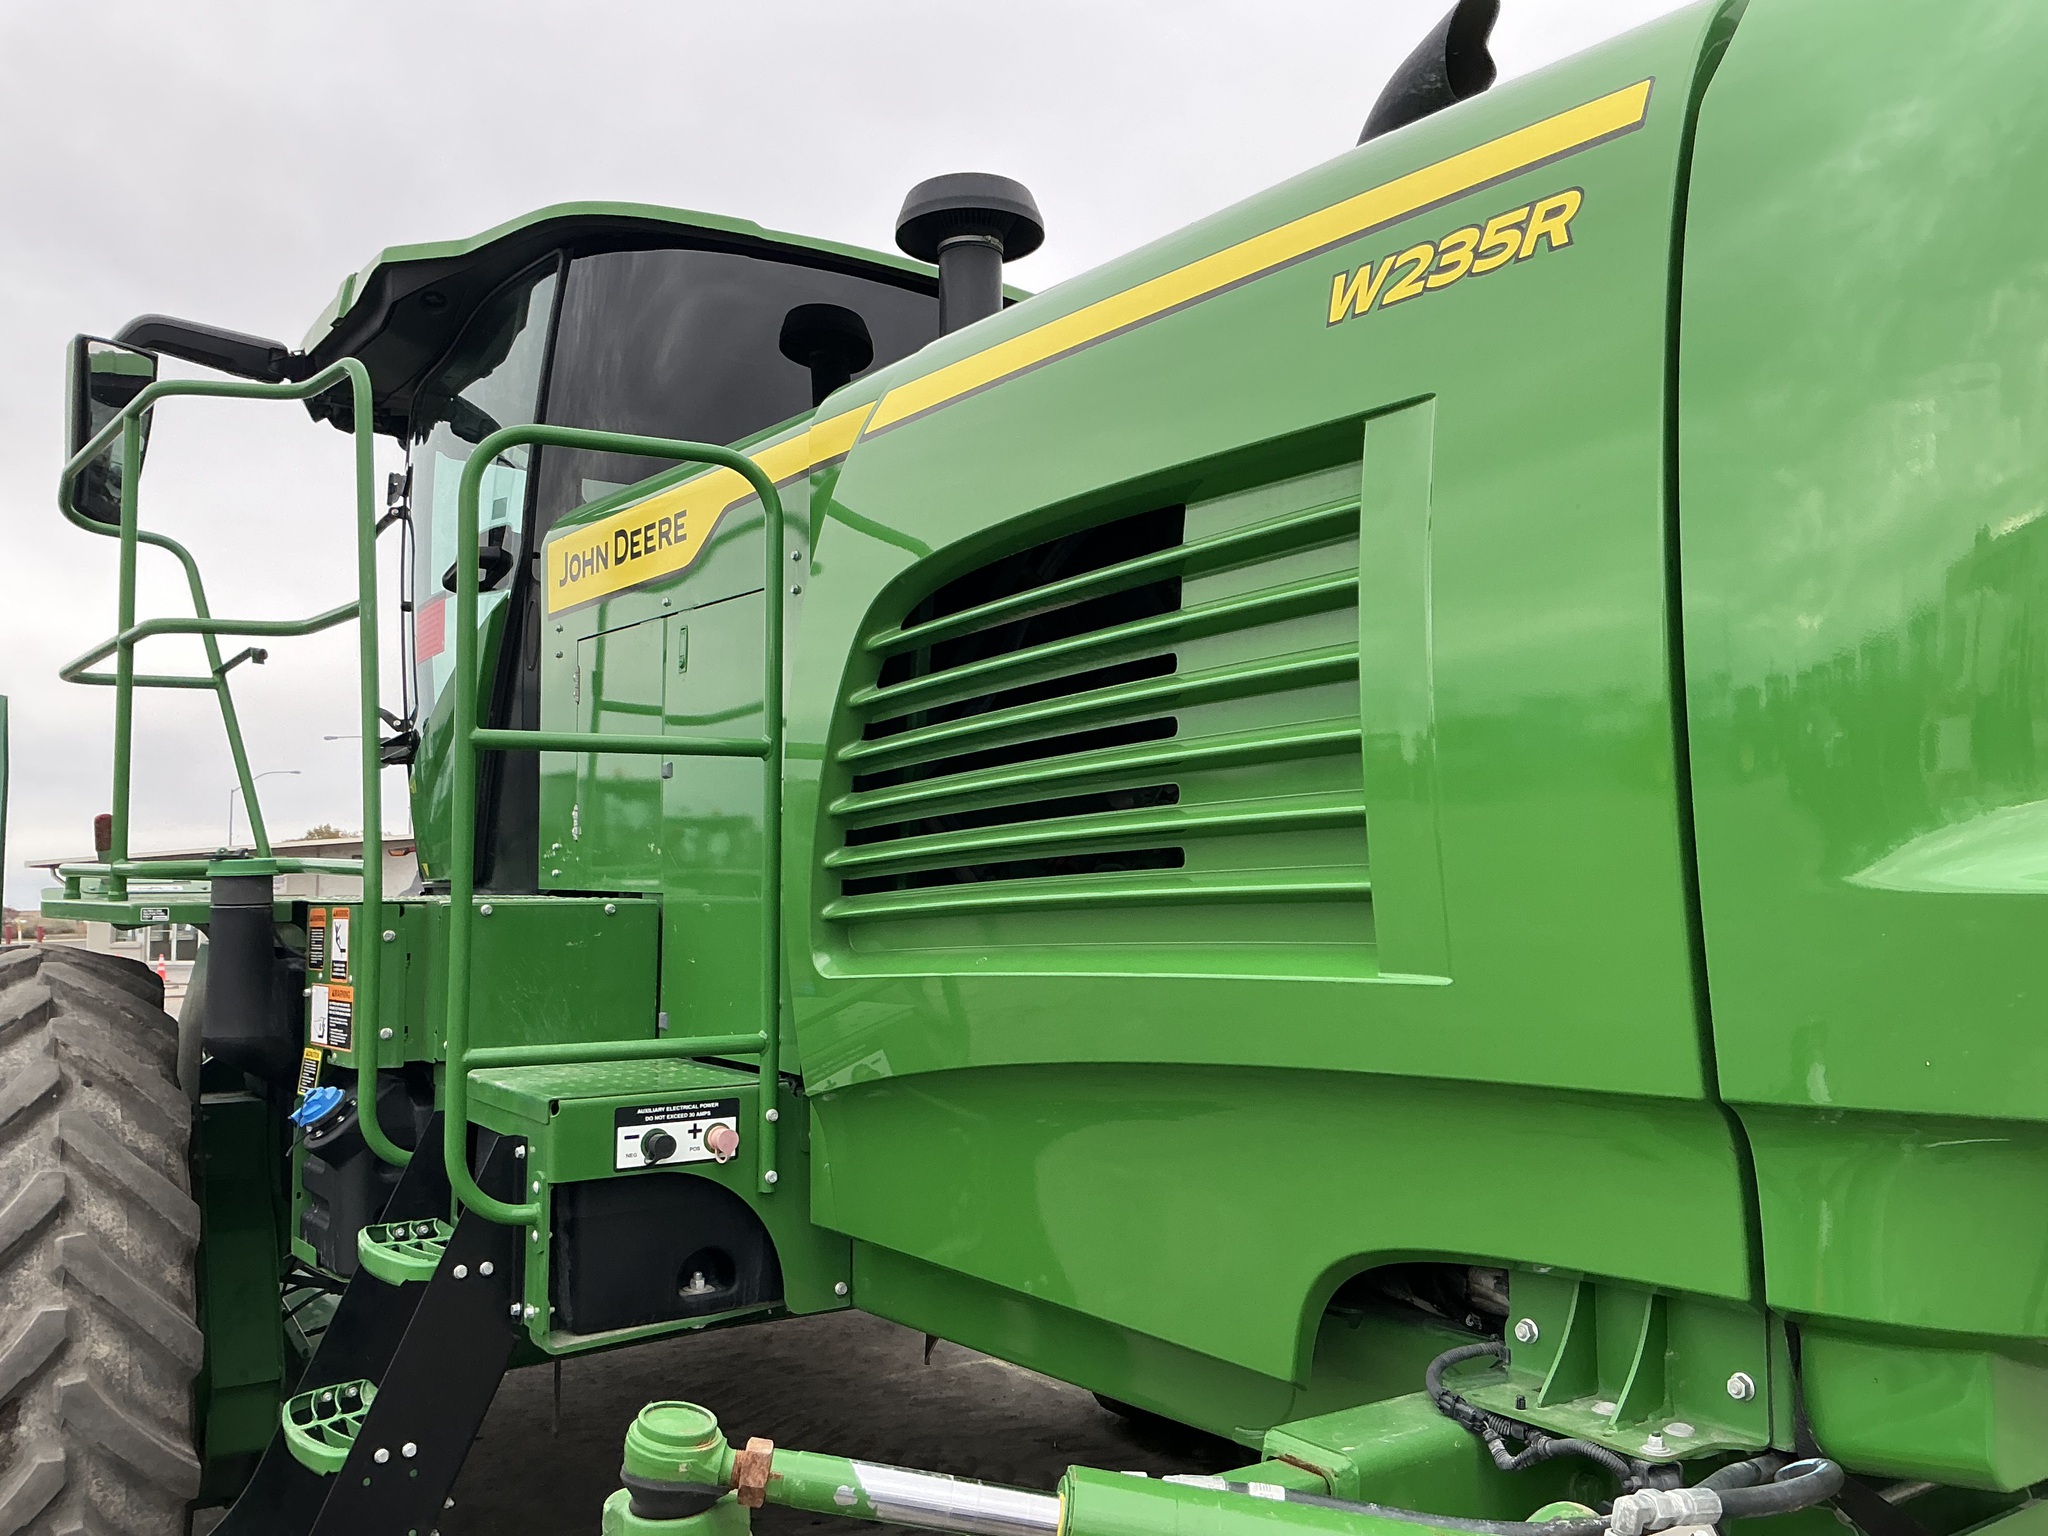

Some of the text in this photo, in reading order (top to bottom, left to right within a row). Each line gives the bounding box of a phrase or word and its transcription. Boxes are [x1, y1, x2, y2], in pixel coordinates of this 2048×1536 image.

[1327, 187, 1583, 327] W235R
[559, 509, 688, 588] JOHN DEERE
[637, 1106, 666, 1115] AUXILIARY
[666, 1104, 699, 1112] ELECTRICAL
[666, 1112, 689, 1120] EXCEED
